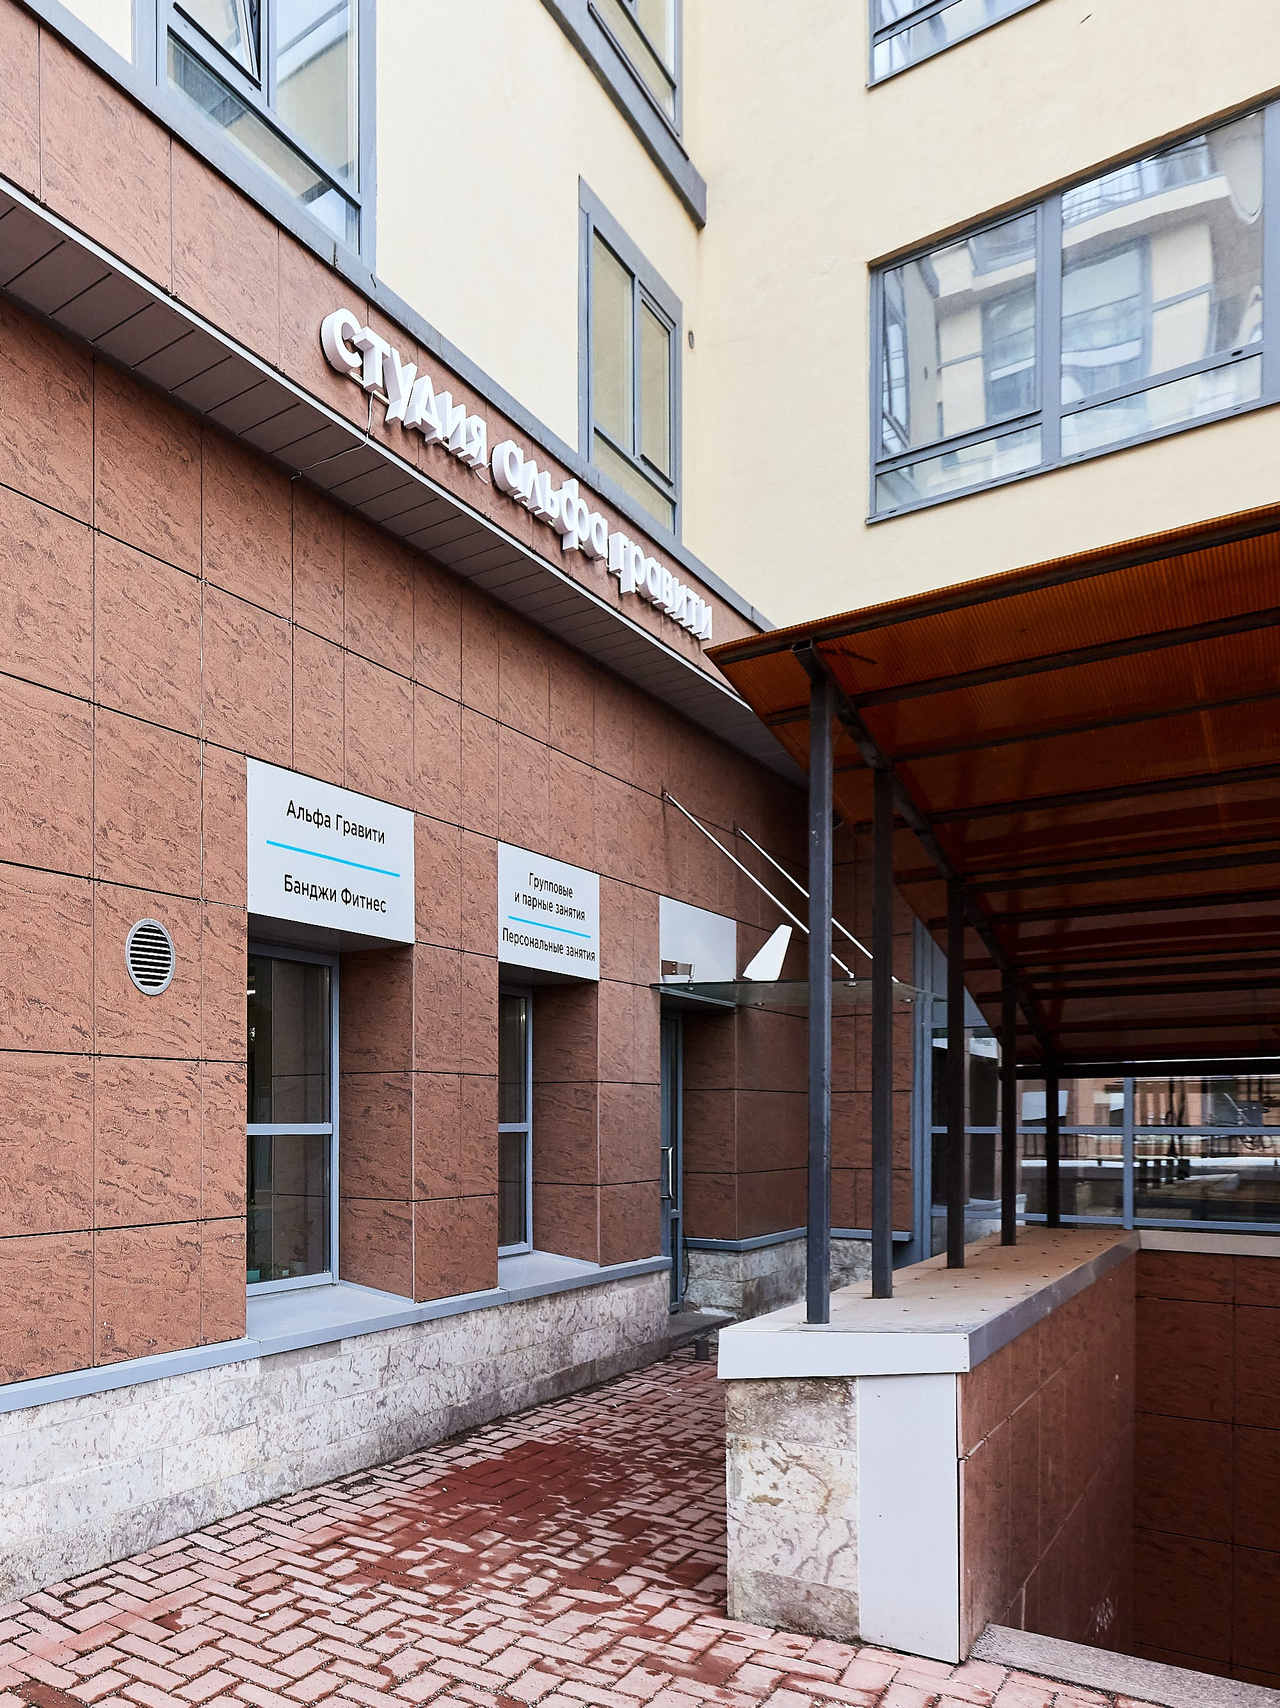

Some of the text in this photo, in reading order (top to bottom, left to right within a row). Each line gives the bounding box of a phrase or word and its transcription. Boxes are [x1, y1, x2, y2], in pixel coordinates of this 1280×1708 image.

[286, 800, 385, 844] Альфа Гравити
[284, 874, 387, 913] Банджи Фитнес
[529, 872, 573, 898] Групповые
[514, 891, 586, 921] и парные занятия
[502, 927, 596, 962] Персональные занятия
